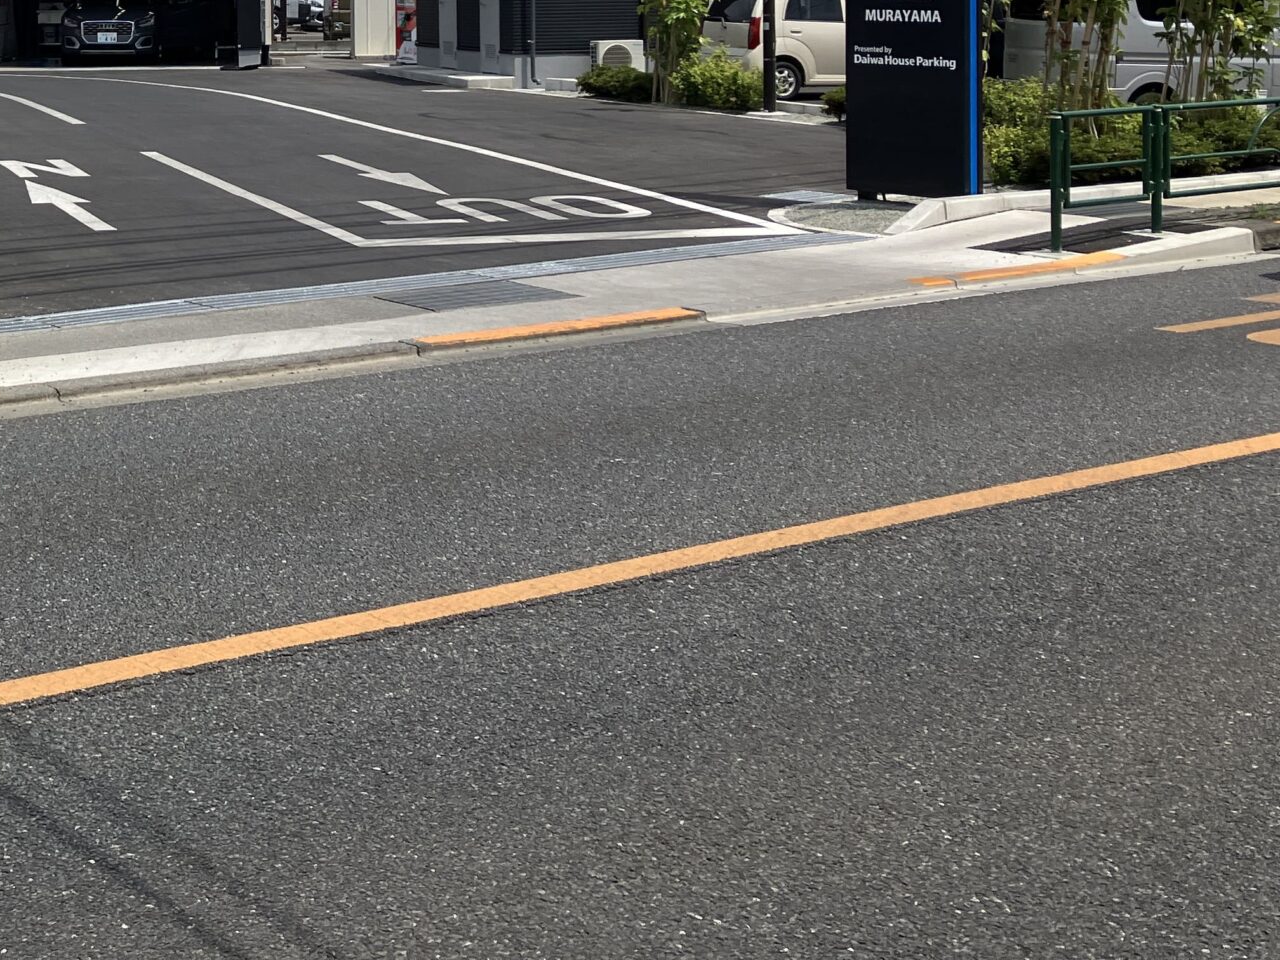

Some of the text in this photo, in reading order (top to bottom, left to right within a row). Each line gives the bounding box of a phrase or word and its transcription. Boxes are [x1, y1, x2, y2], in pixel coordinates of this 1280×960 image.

[864, 9, 942, 23] MURAYAMA
[854, 45, 892, 54] Presented by
[853, 54, 957, 71] Daiwa House Parking
